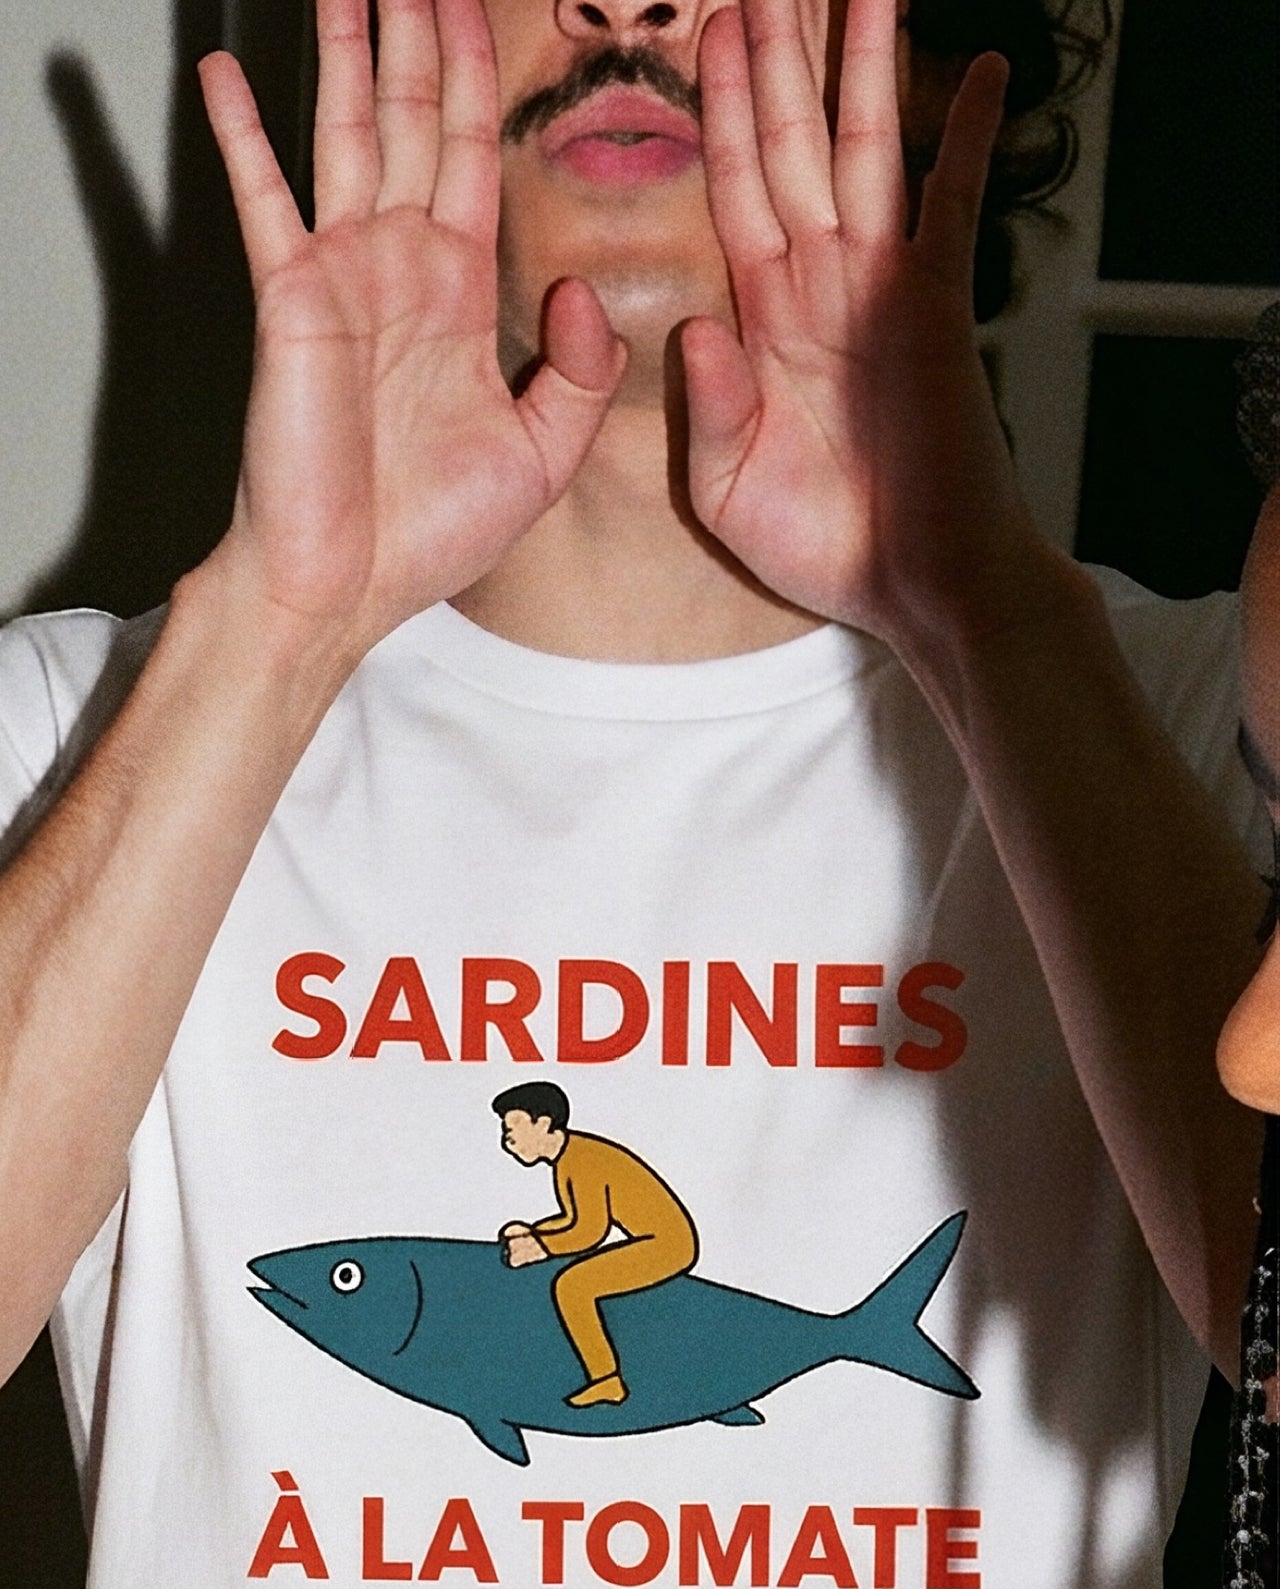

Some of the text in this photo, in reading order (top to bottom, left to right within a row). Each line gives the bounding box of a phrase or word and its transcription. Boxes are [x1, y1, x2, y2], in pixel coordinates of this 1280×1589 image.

[270, 951, 969, 1073] SARDINES
[247, 1470, 330, 1580] À
[361, 1497, 500, 1584] LA
